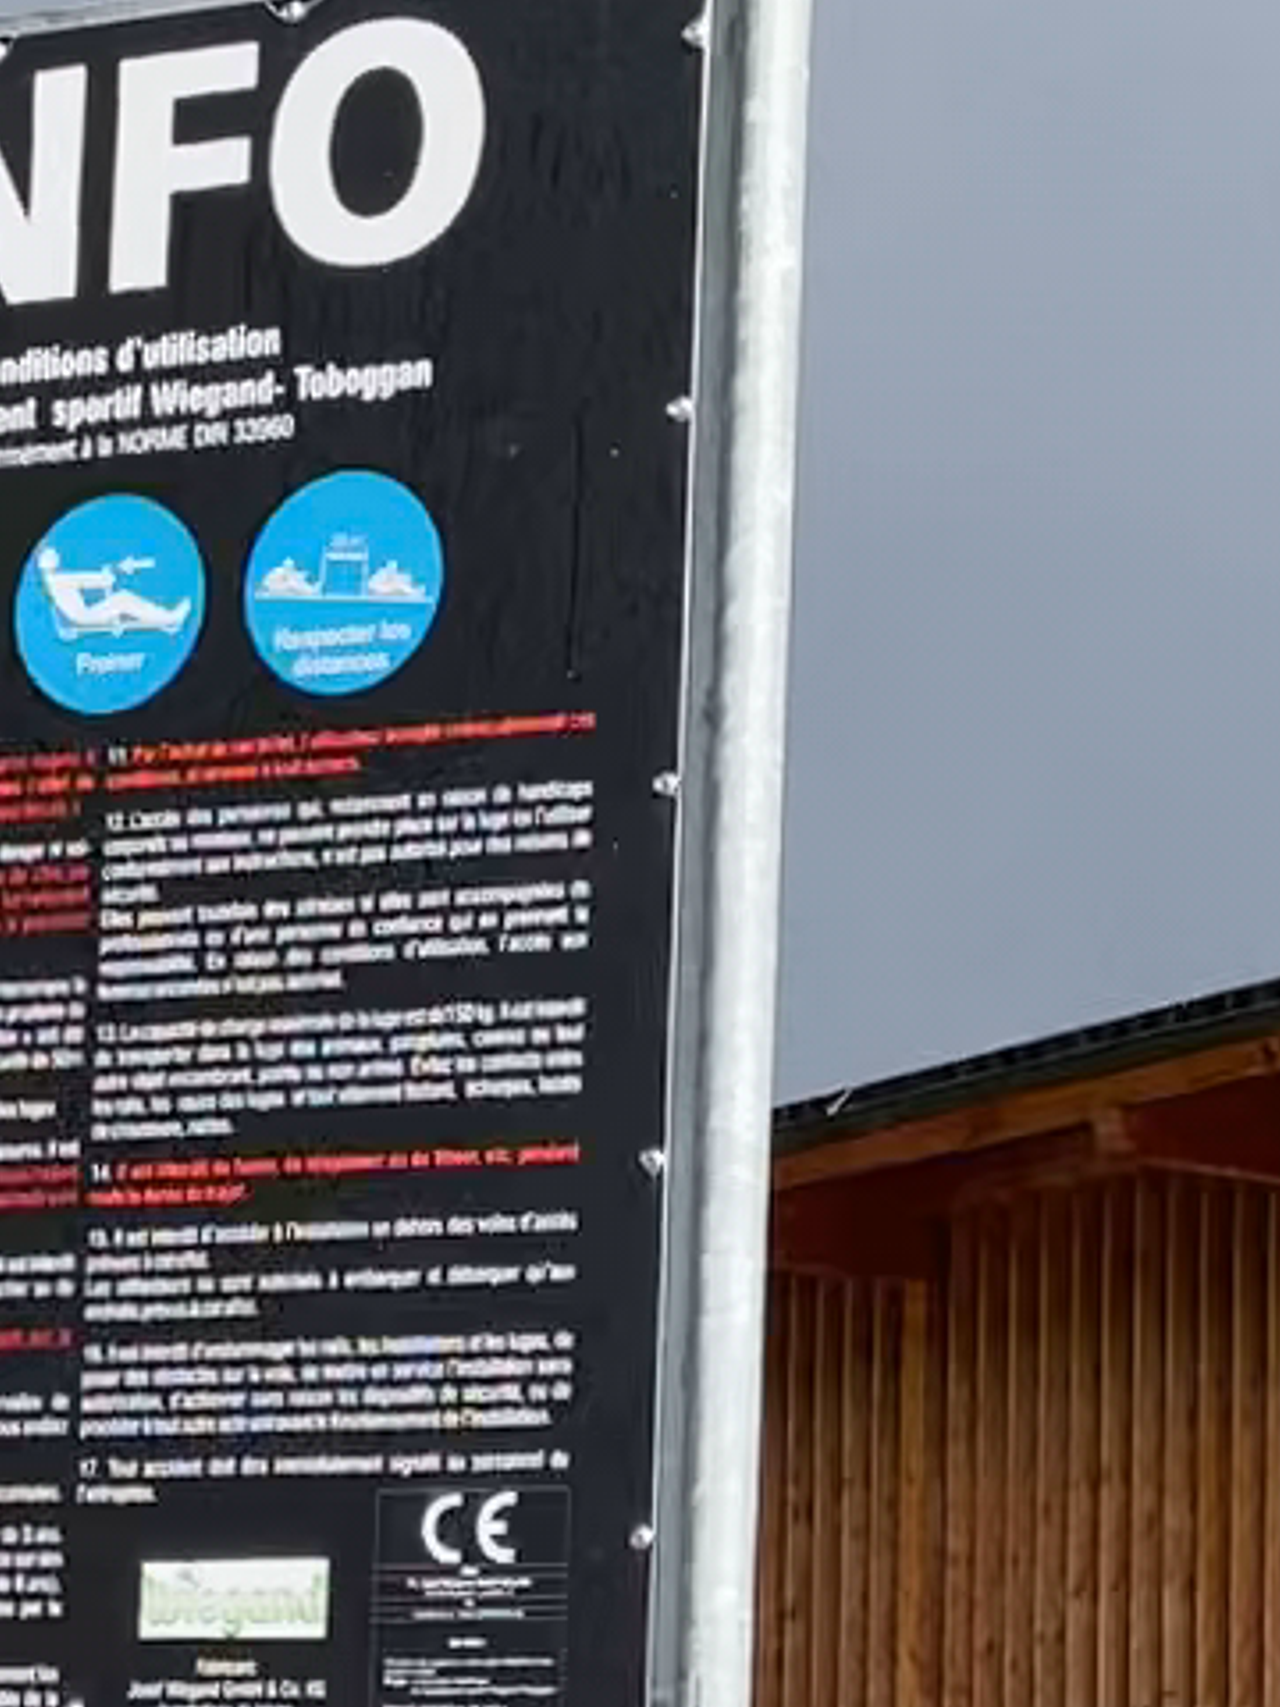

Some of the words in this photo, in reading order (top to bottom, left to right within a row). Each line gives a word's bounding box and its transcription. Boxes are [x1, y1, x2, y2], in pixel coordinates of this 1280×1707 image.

[117, 320, 282, 373] d'utilisation
[51, 382, 142, 433] sportif
[150, 368, 285, 423] Wiegand-
[293, 352, 434, 409] Toboggan
[117, 424, 188, 458] NORME
[419, 1490, 518, 1564] CE
